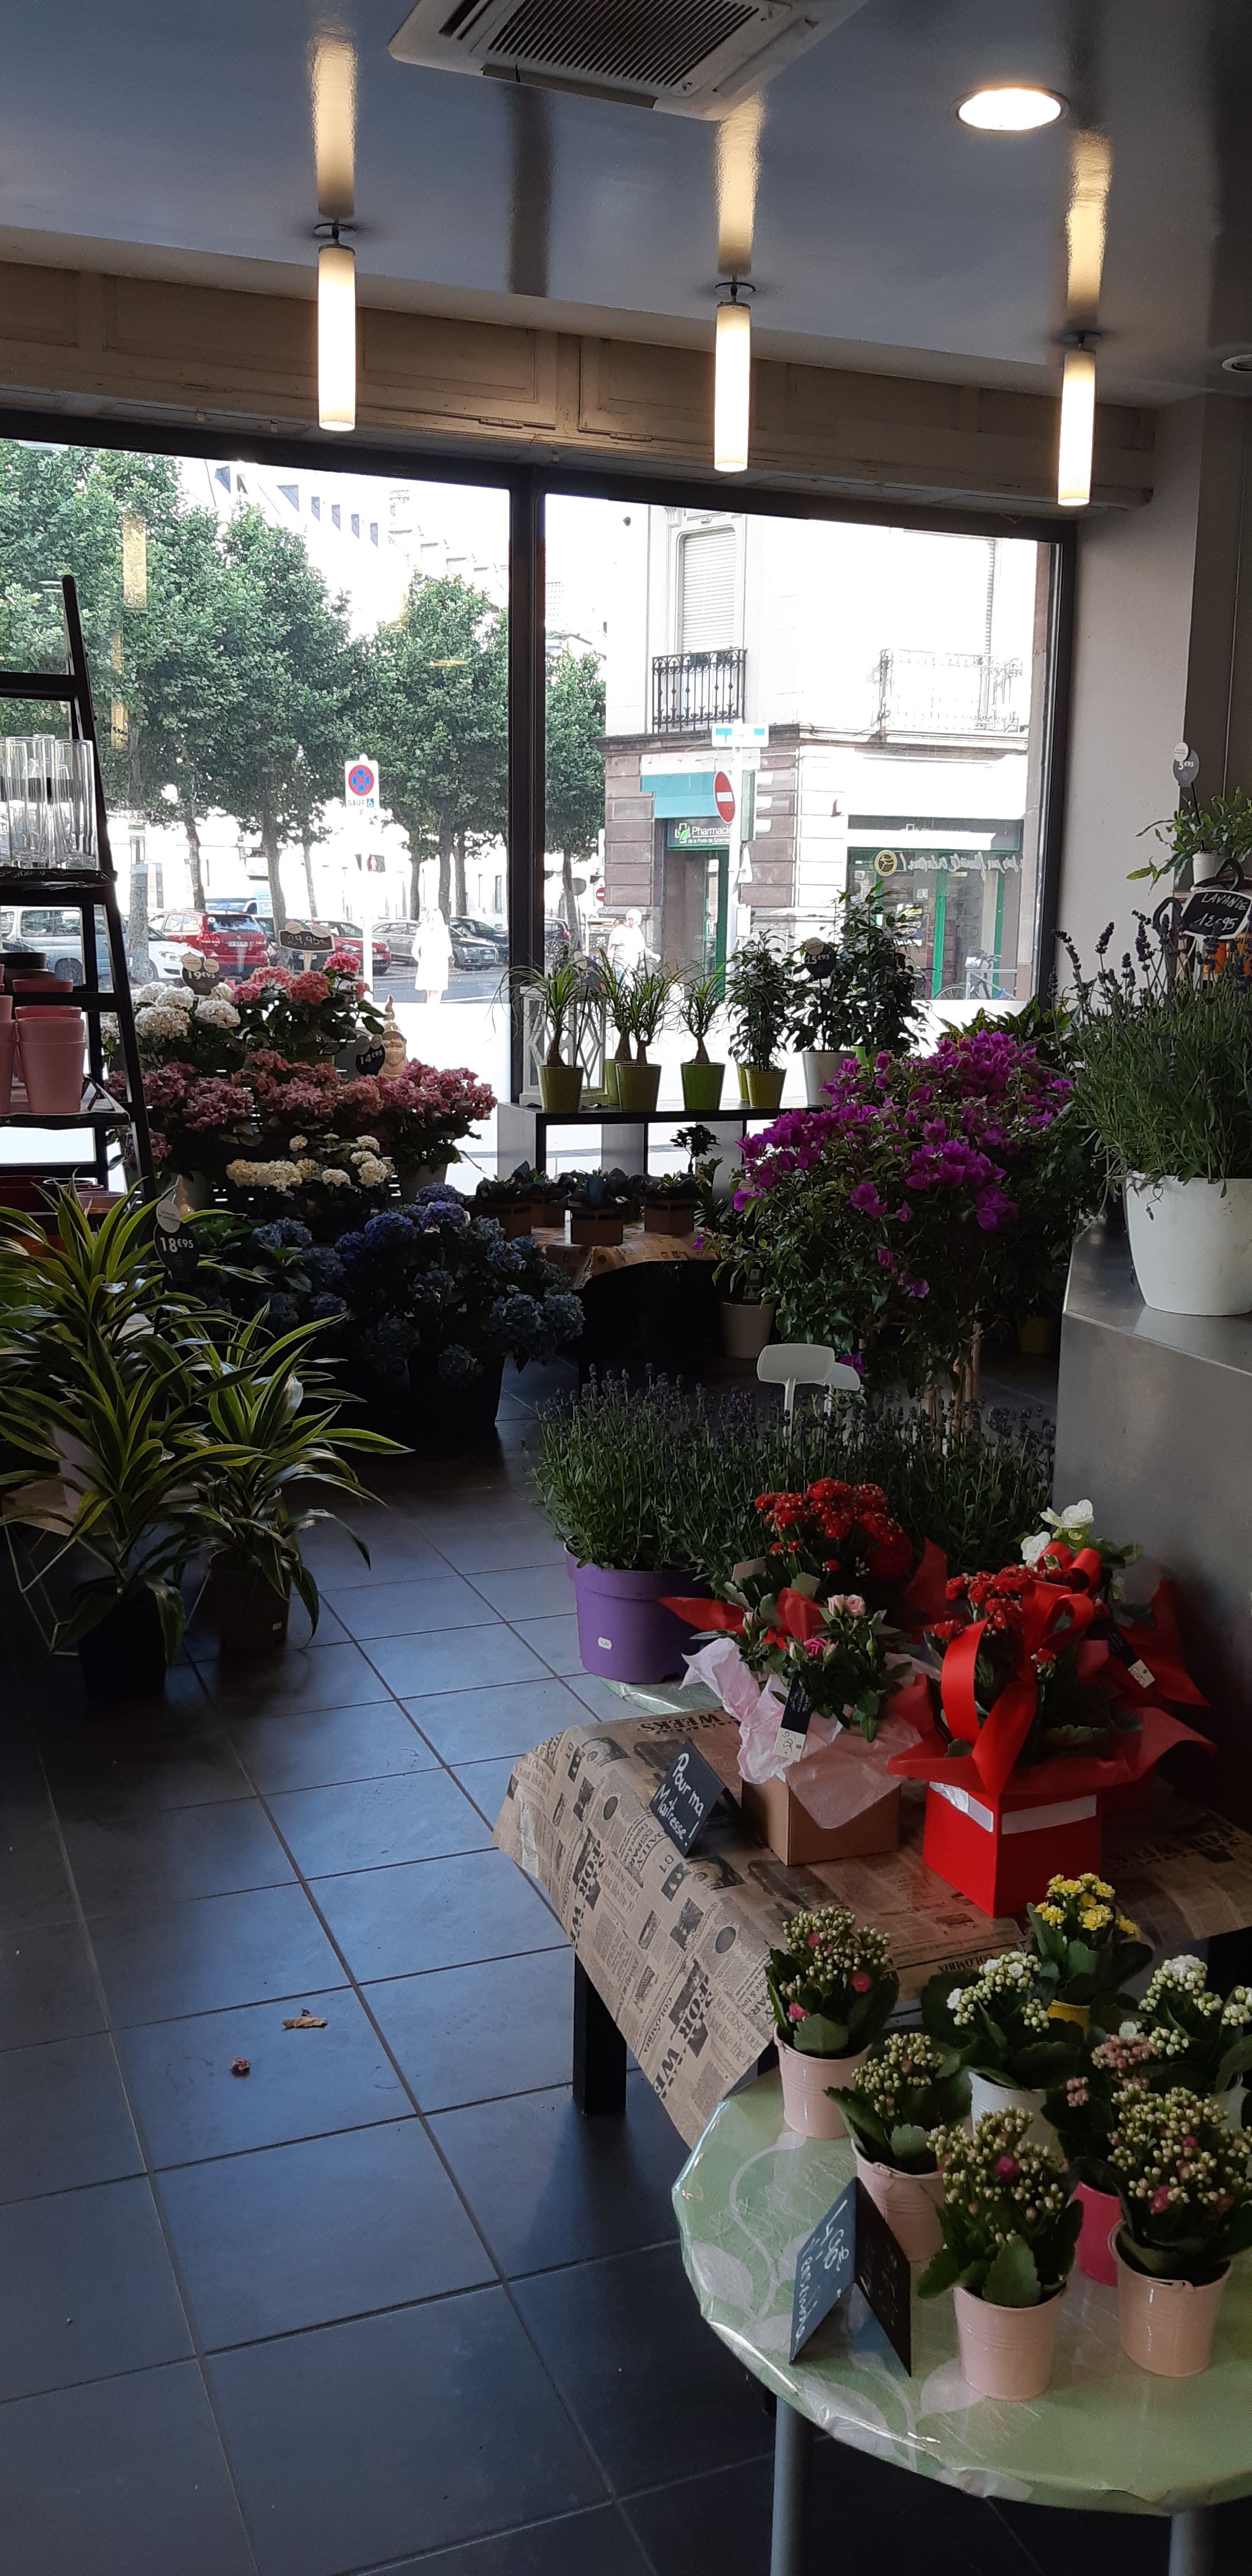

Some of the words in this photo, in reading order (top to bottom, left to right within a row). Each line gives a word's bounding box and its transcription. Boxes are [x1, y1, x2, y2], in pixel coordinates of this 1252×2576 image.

[1178, 761, 1194, 770] 5€95
[1201, 893, 1248, 911] LAVANDE
[287, 934, 328, 946] 29,95€
[805, 954, 830, 965] 15€95
[187, 970, 216, 980] 19€95
[160, 1237, 194, 1253] 18€95
[672, 1753, 691, 1795] Pour
[688, 1790, 704, 1817] ma
